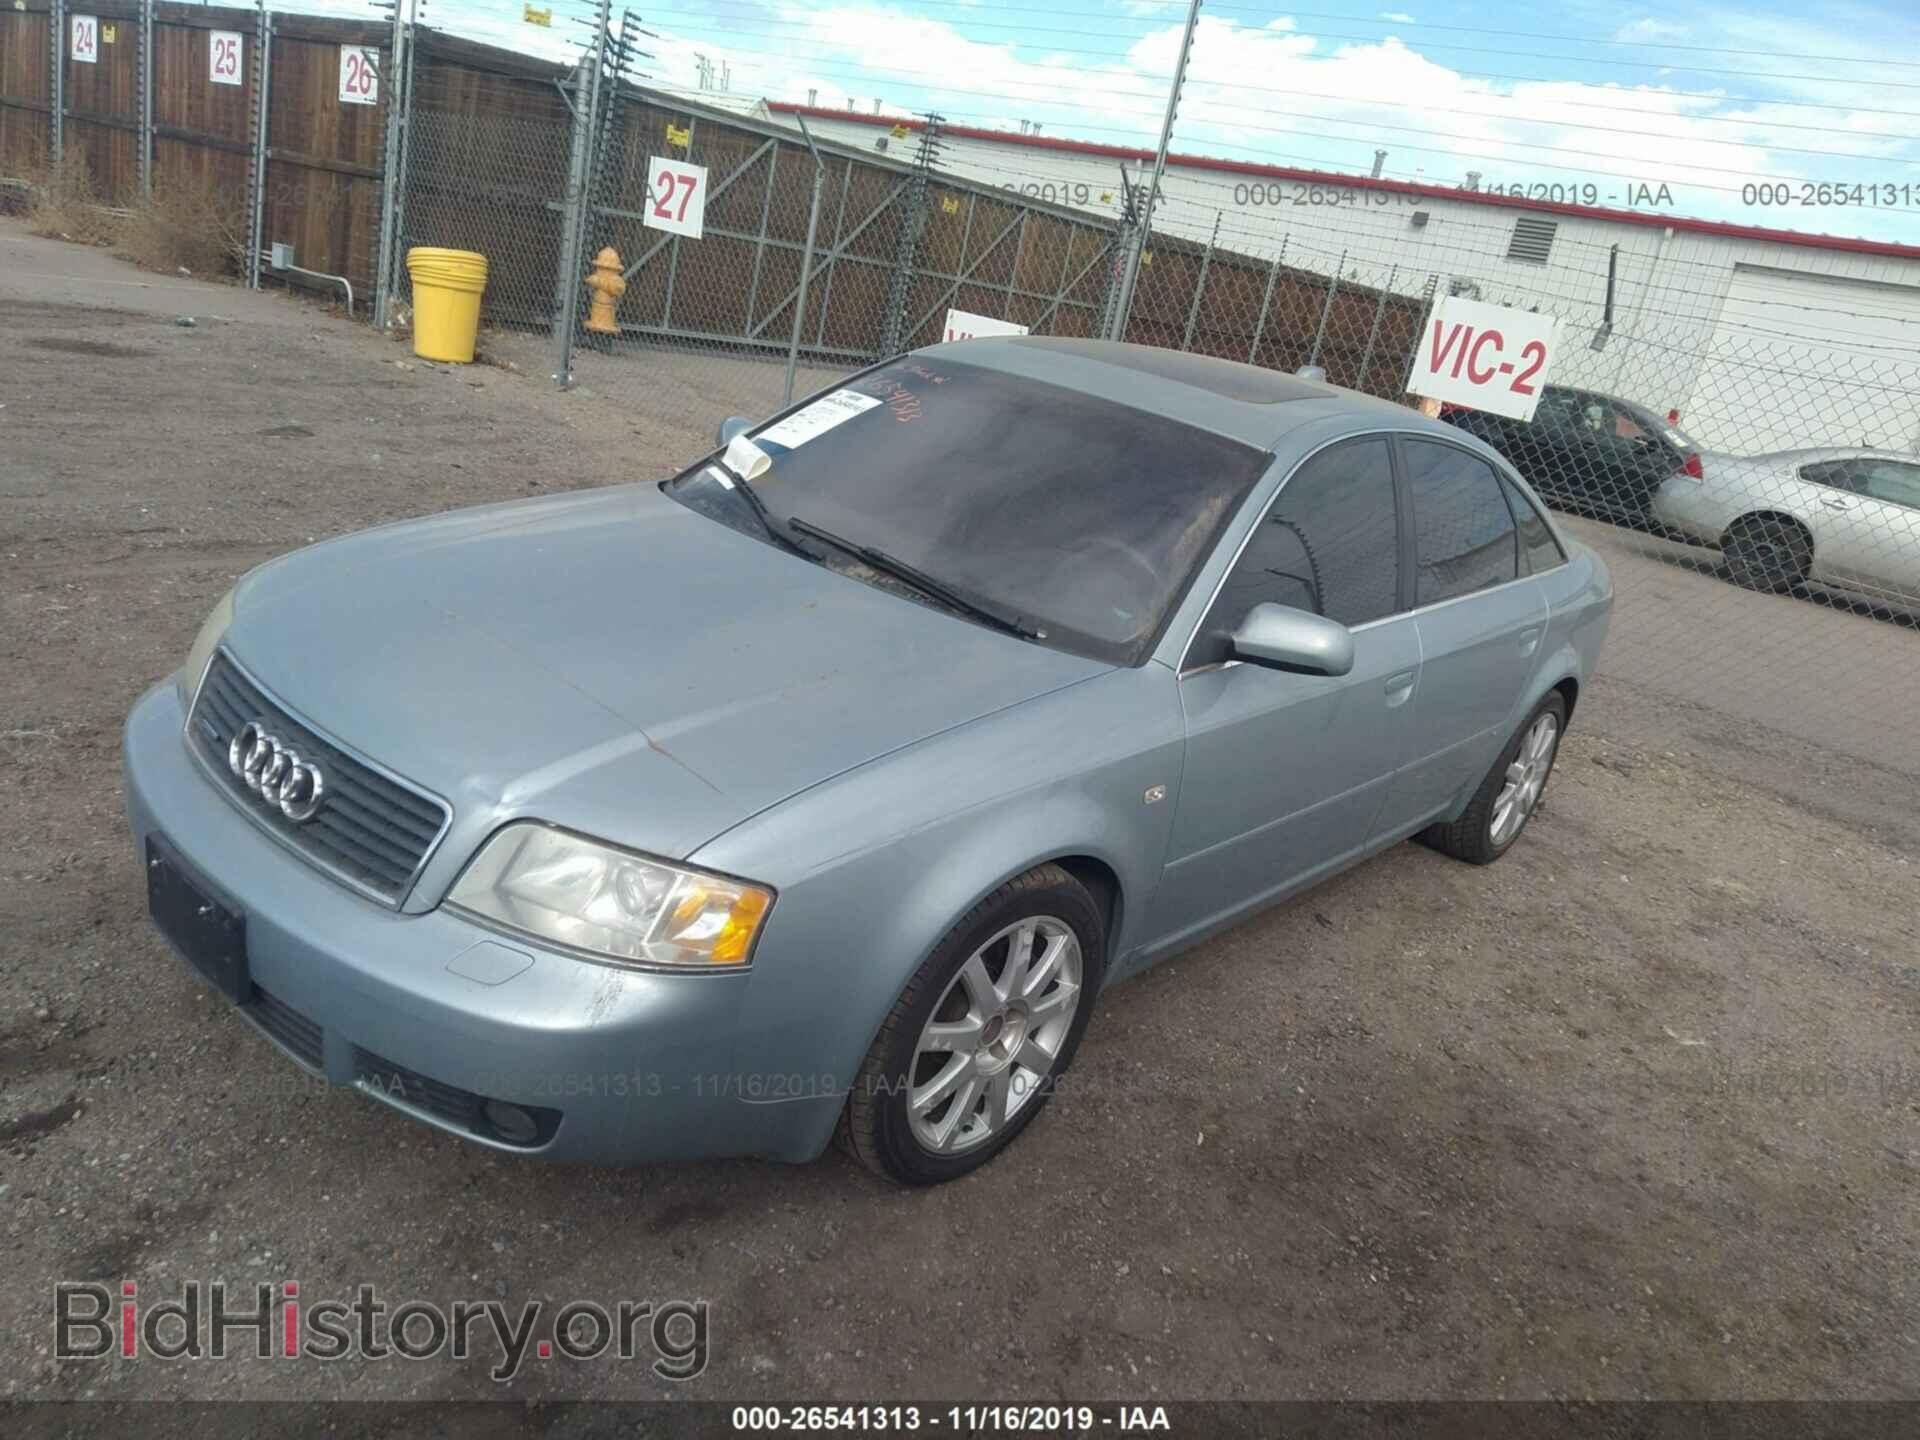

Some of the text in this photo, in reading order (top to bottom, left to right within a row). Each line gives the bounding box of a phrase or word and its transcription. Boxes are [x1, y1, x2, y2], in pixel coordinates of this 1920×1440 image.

[75, 21, 94, 54] 24
[214, 39, 237, 76] 25
[345, 53, 372, 96] 26
[653, 169, 698, 223] 27
[1428, 319, 1547, 396] VIC-2
